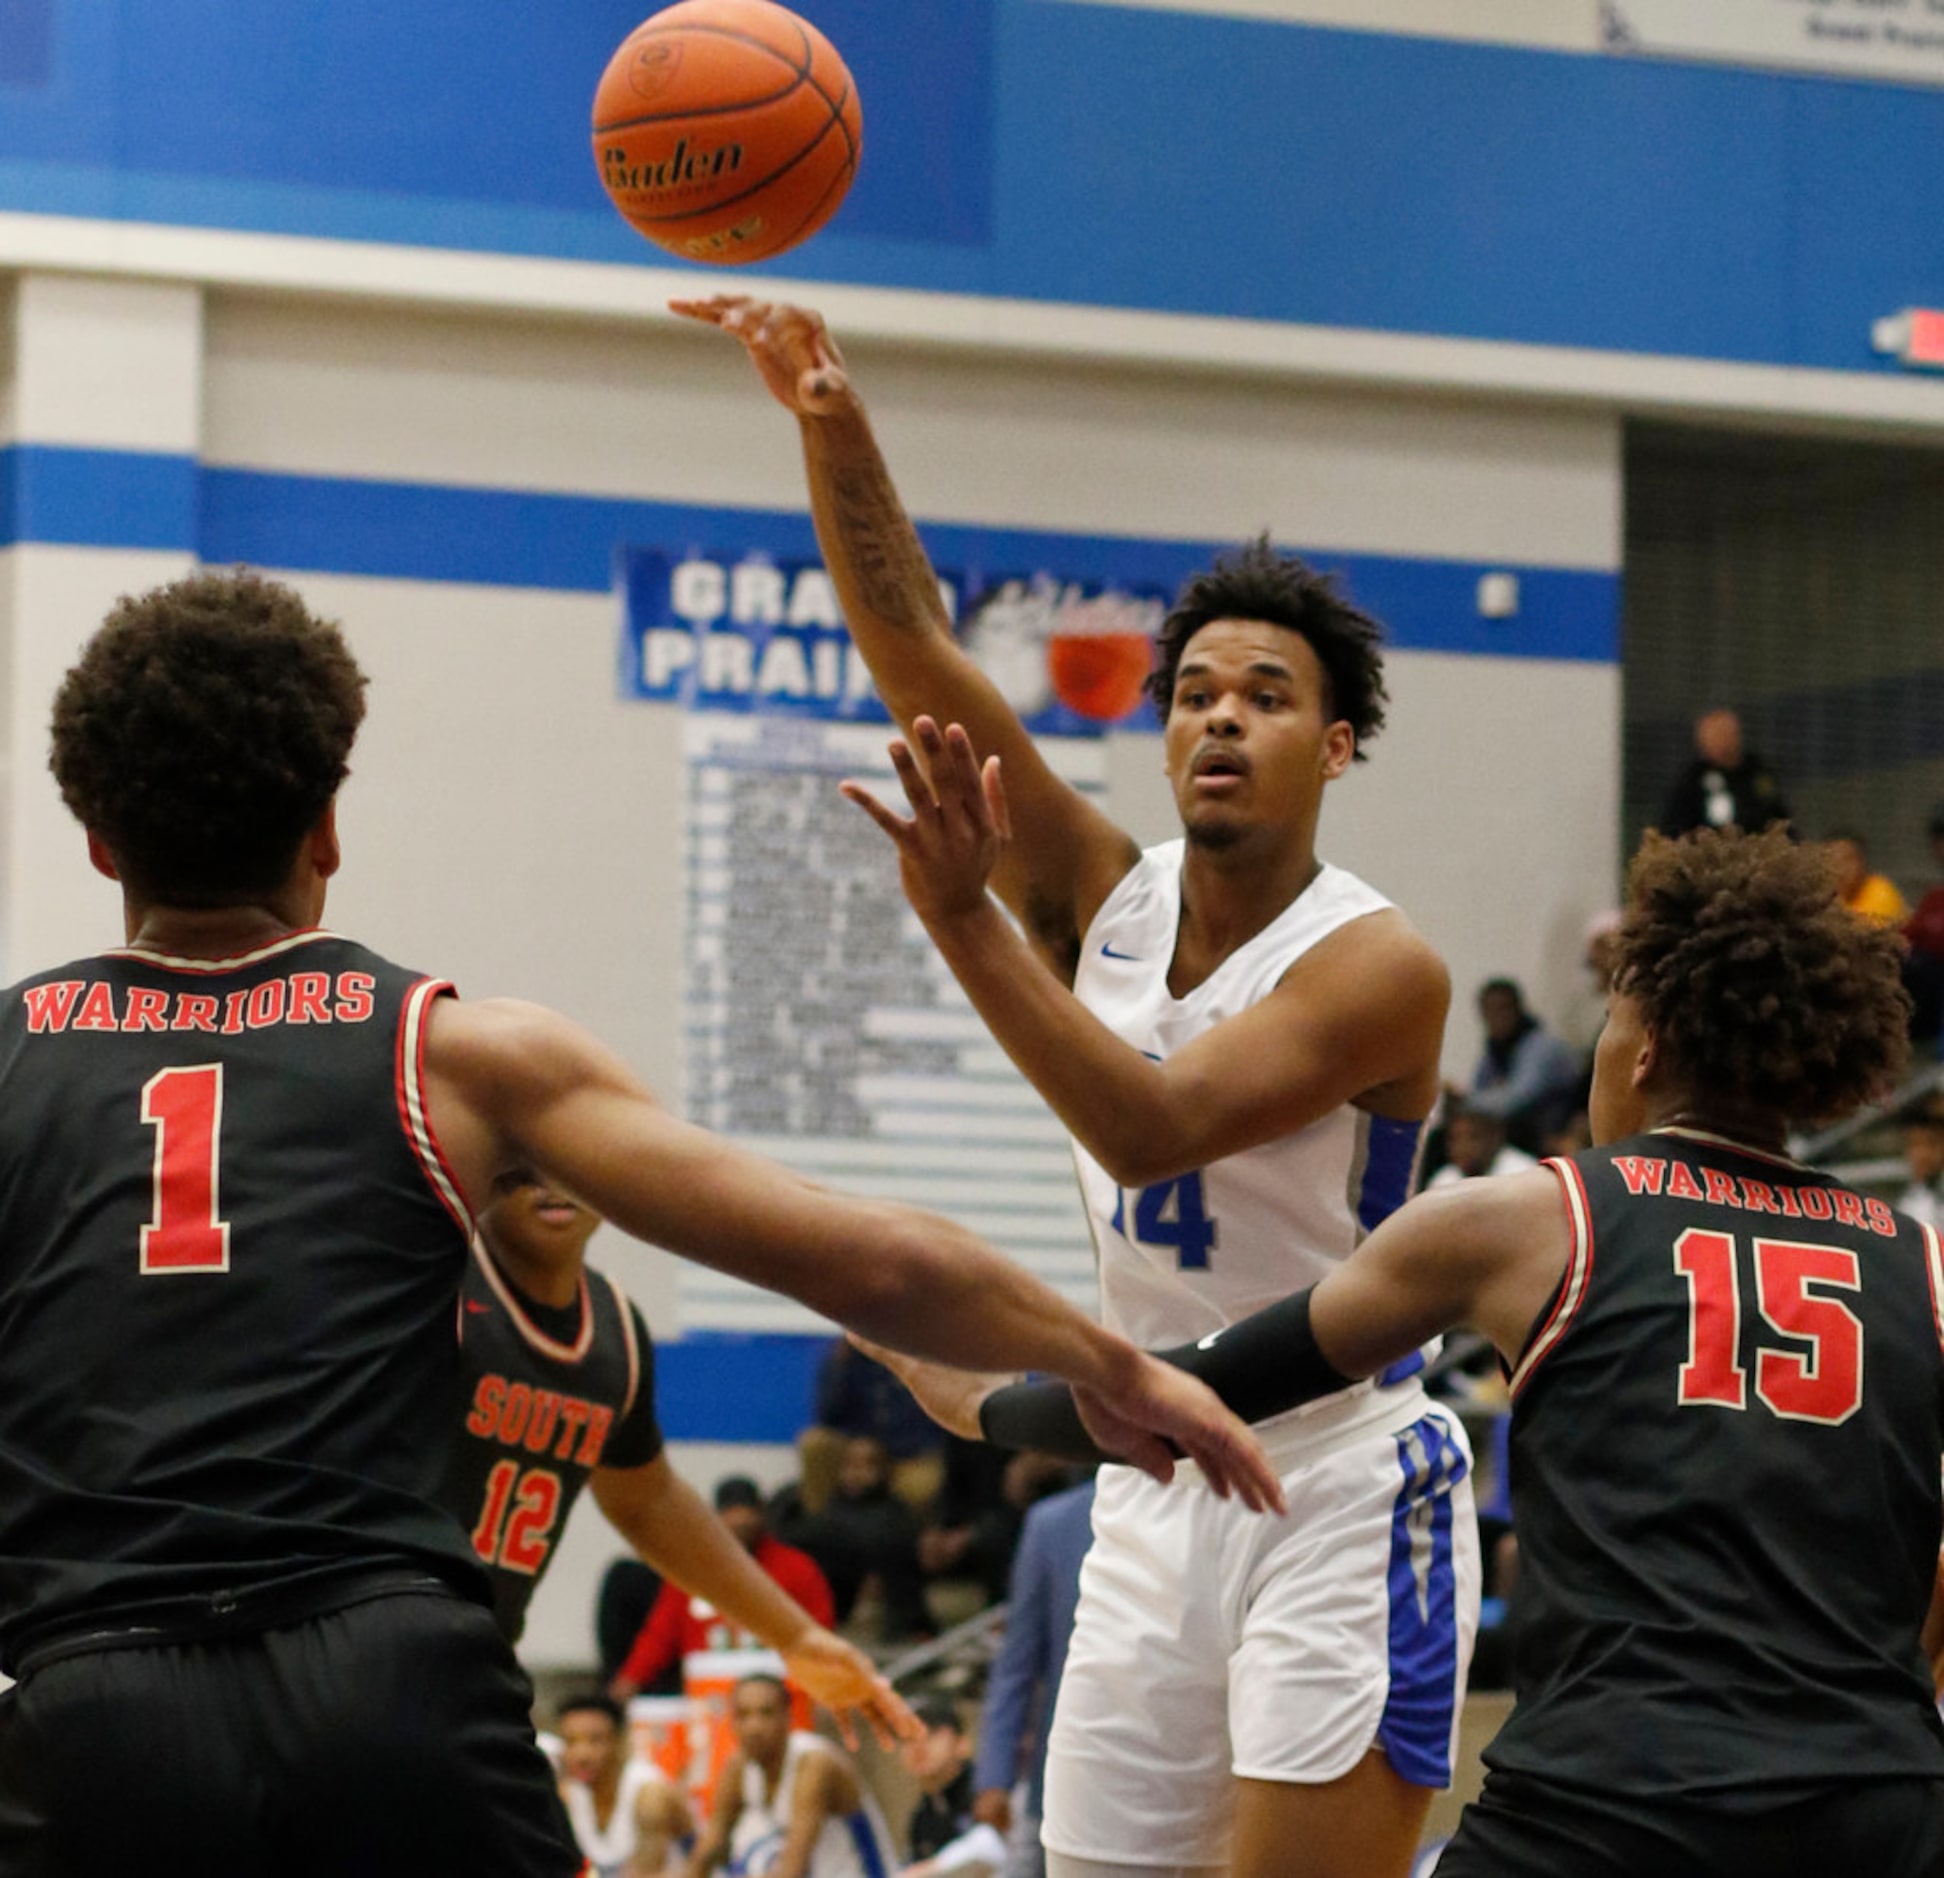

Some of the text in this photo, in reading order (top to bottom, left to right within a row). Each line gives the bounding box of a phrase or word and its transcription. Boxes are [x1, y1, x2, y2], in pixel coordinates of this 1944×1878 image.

[604, 138, 743, 190] Baden
[671, 560, 956, 630] GRA
[23, 971, 376, 1035] WARRIORS
[139, 1062, 230, 1275] 1
[1611, 1155, 1898, 1238] WARRIORS
[1673, 1227, 1863, 1427] 15
[466, 1372, 614, 1468] SOUTH
[471, 1458, 562, 1576] 12
